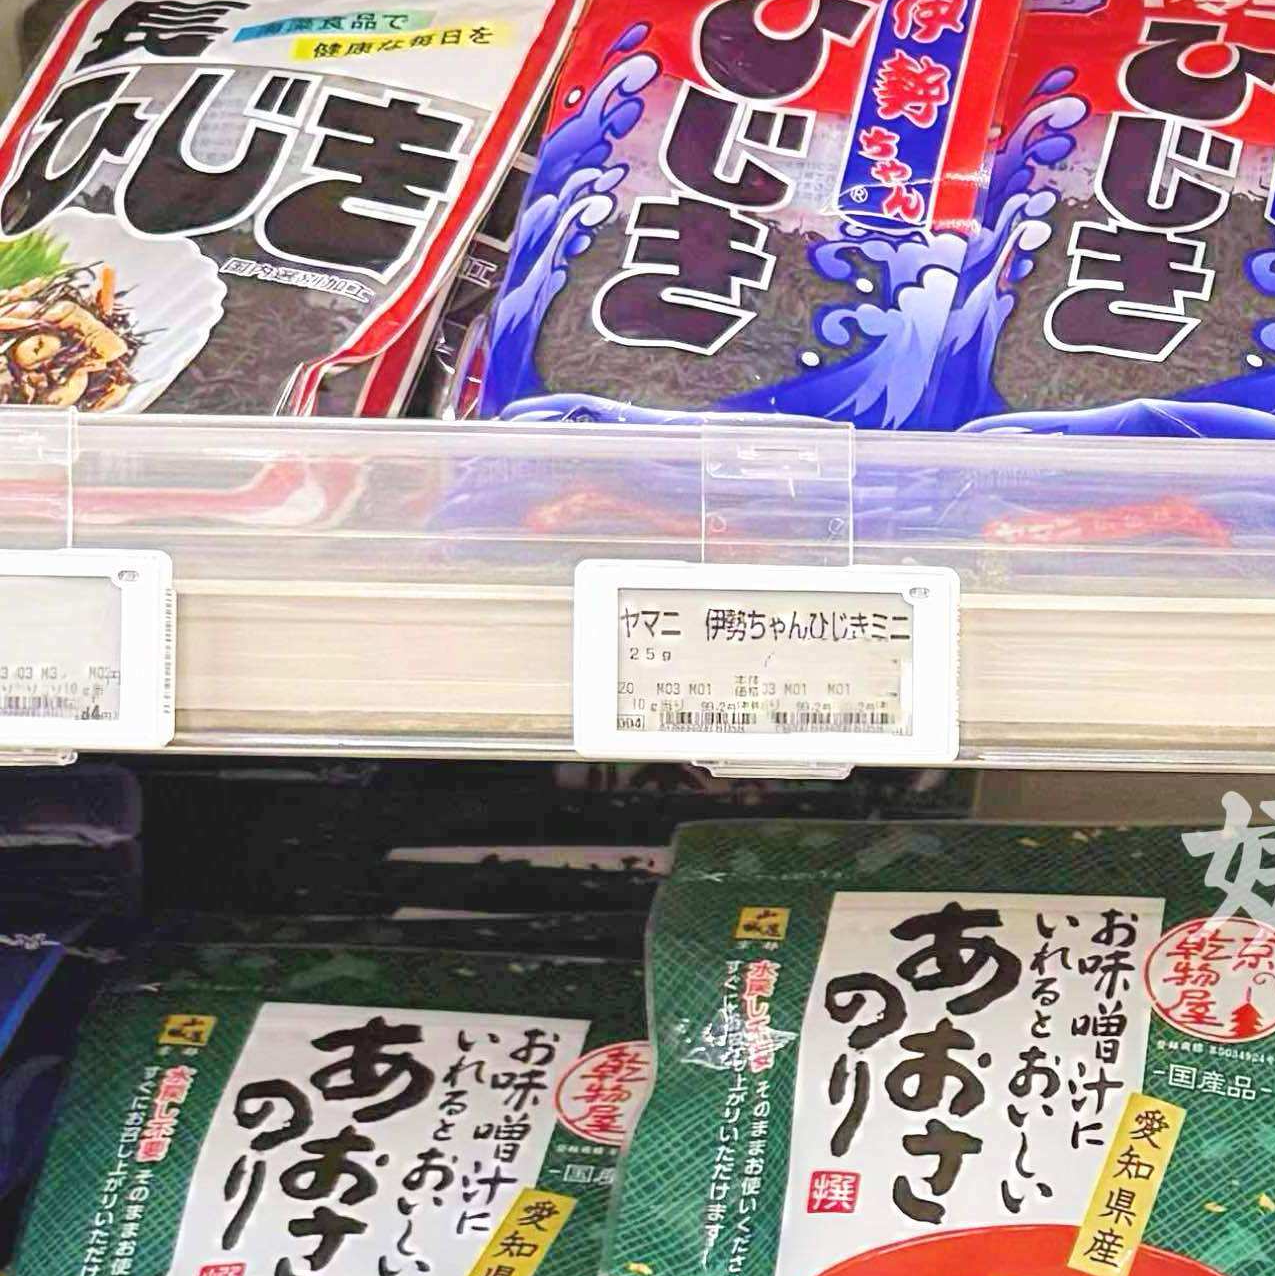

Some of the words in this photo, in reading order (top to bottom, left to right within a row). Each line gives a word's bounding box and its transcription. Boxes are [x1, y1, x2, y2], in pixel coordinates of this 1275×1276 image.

[77, 0, 252, 68] 長
[312, 26, 495, 60] 健康な毎日を
[0, 65, 484, 283] ひじき
[621, 610, 681, 638] ヤマニ
[705, 608, 911, 642] 伊勢ちゃんひじきミニ
[629, 647, 672, 662] 25g
[1069, 908, 1138, 1150] お味噌汁に
[1163, 925, 1234, 1026] 乾物屋
[456, 1029, 560, 1234] お味噌汁に
[824, 971, 907, 1157] のり
[885, 902, 1024, 1224] あおさ
[1001, 911, 1080, 1215] いれるとおいしい
[223, 1078, 314, 1251] のり
[1082, 1108, 1172, 1271] 愛知県産
